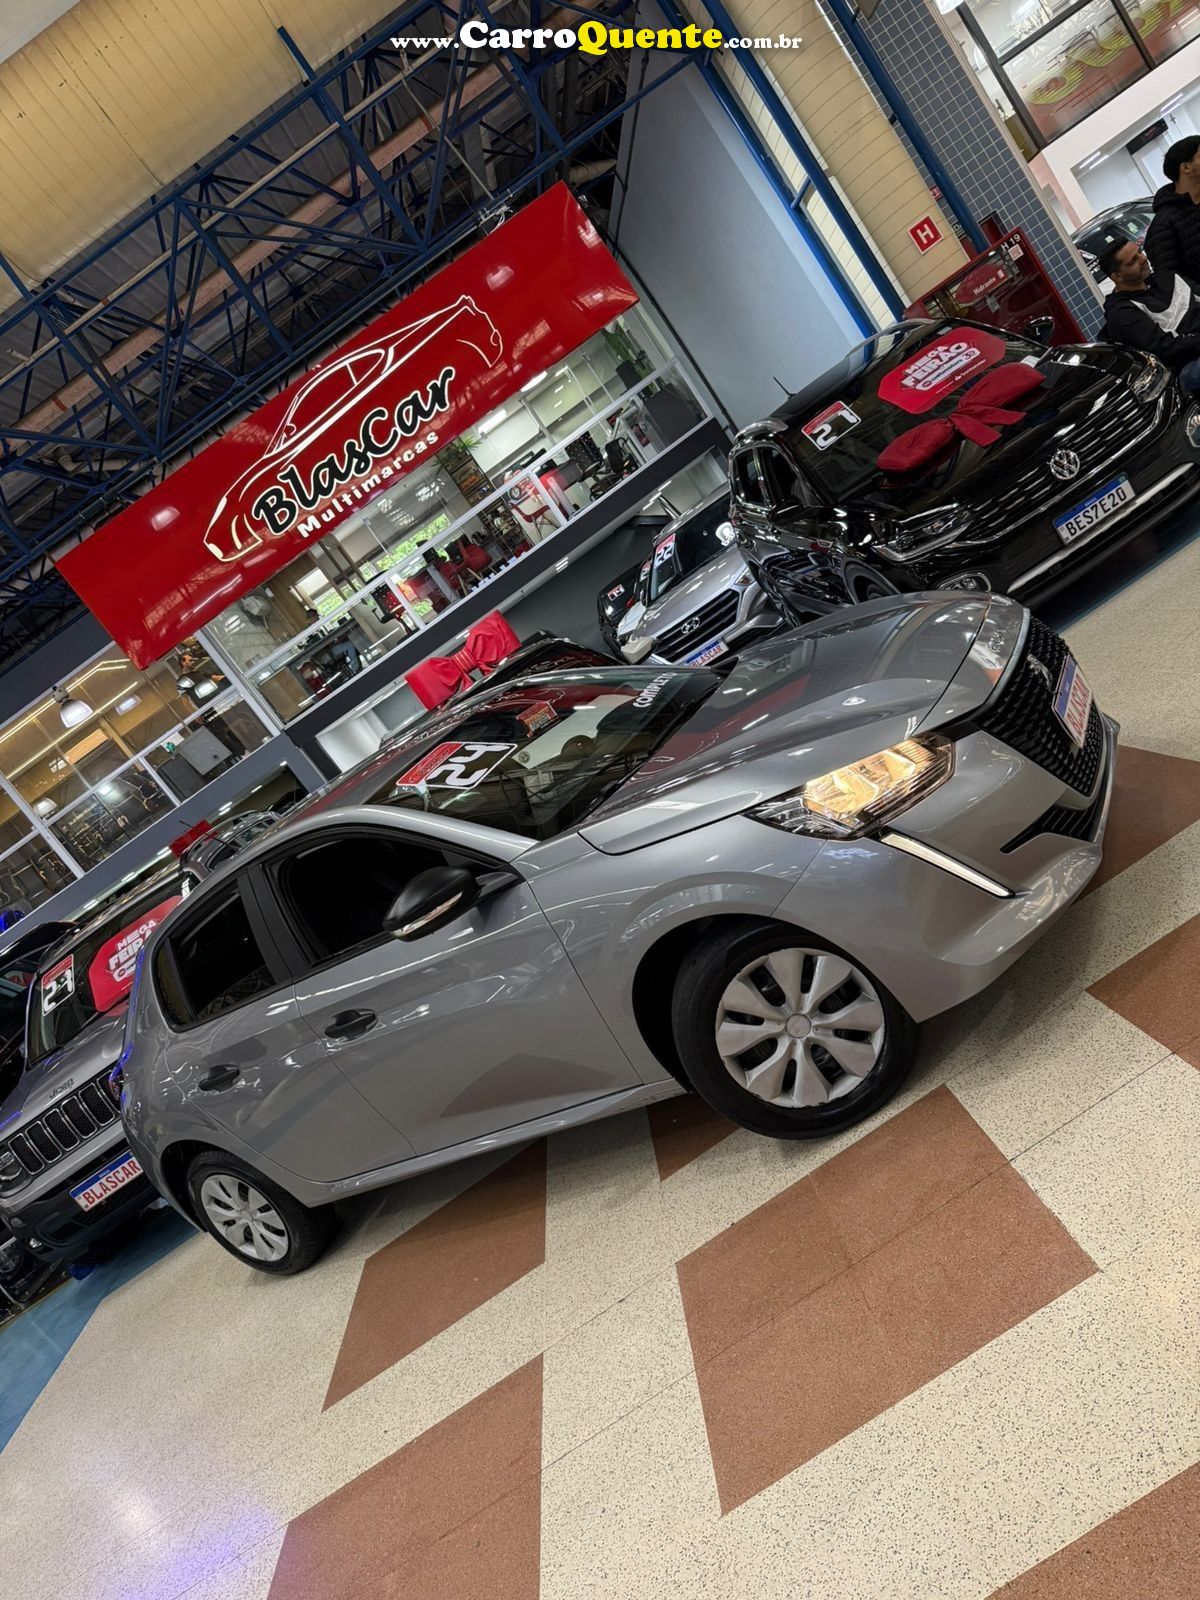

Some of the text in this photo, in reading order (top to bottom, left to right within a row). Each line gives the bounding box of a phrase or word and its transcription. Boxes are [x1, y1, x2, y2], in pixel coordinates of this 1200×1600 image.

[916, 223, 935, 244] H
[1000, 233, 1021, 252] H 19
[973, 276, 996, 296] Hidrante
[901, 342, 968, 387] FEIRÃO
[905, 345, 949, 374] MEGA
[252, 366, 455, 535] BlasCar
[296, 431, 439, 538] Multimarcas
[1065, 486, 1127, 537] BES7E20
[690, 643, 724, 667] BLASCAR
[1066, 673, 1090, 738] BLASCAR
[425, 744, 510, 786] 24
[117, 919, 157, 951] MEGA
[49, 1078, 75, 1099] Jeep
[82, 1160, 142, 1206] BLASCAR
